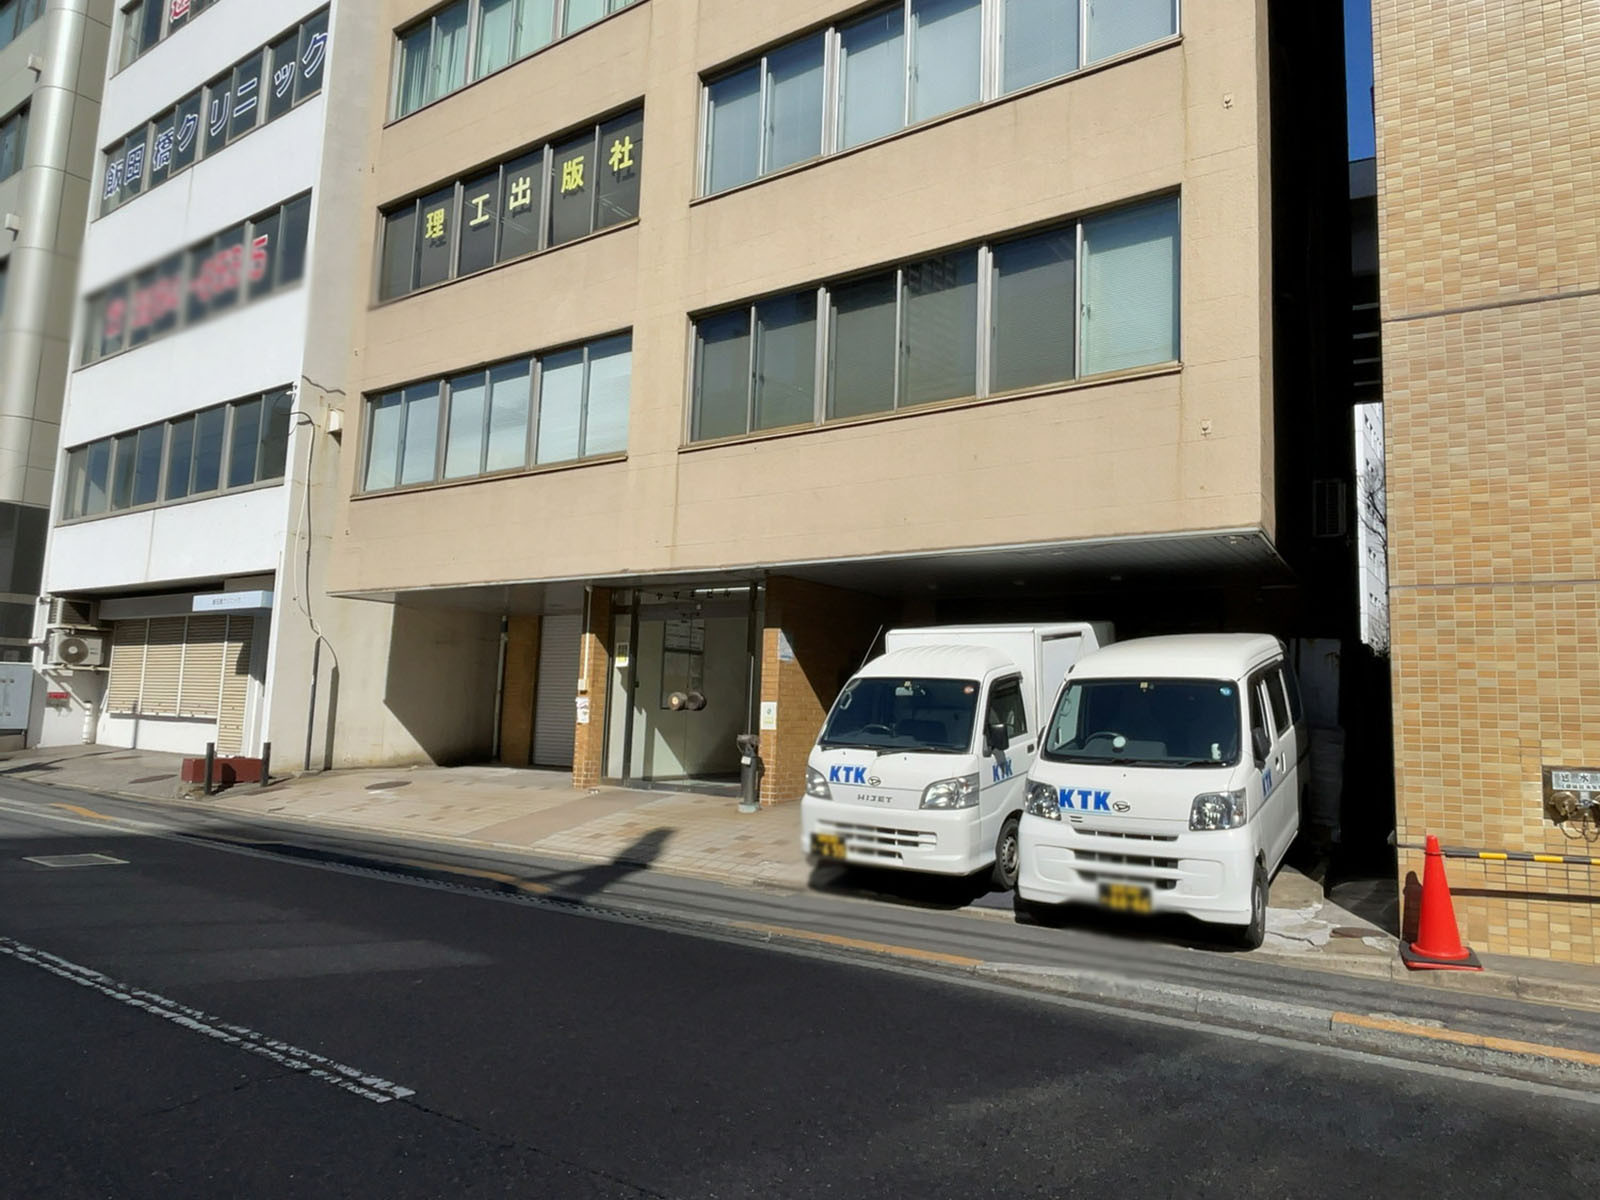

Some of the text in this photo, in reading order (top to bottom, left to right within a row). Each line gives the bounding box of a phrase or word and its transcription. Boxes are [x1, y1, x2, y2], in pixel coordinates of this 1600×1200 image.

[425, 136, 633, 238] 理工出版社
[829, 765, 867, 784] KTK
[857, 793, 893, 803] HIJET
[1059, 788, 1111, 811] KTK
